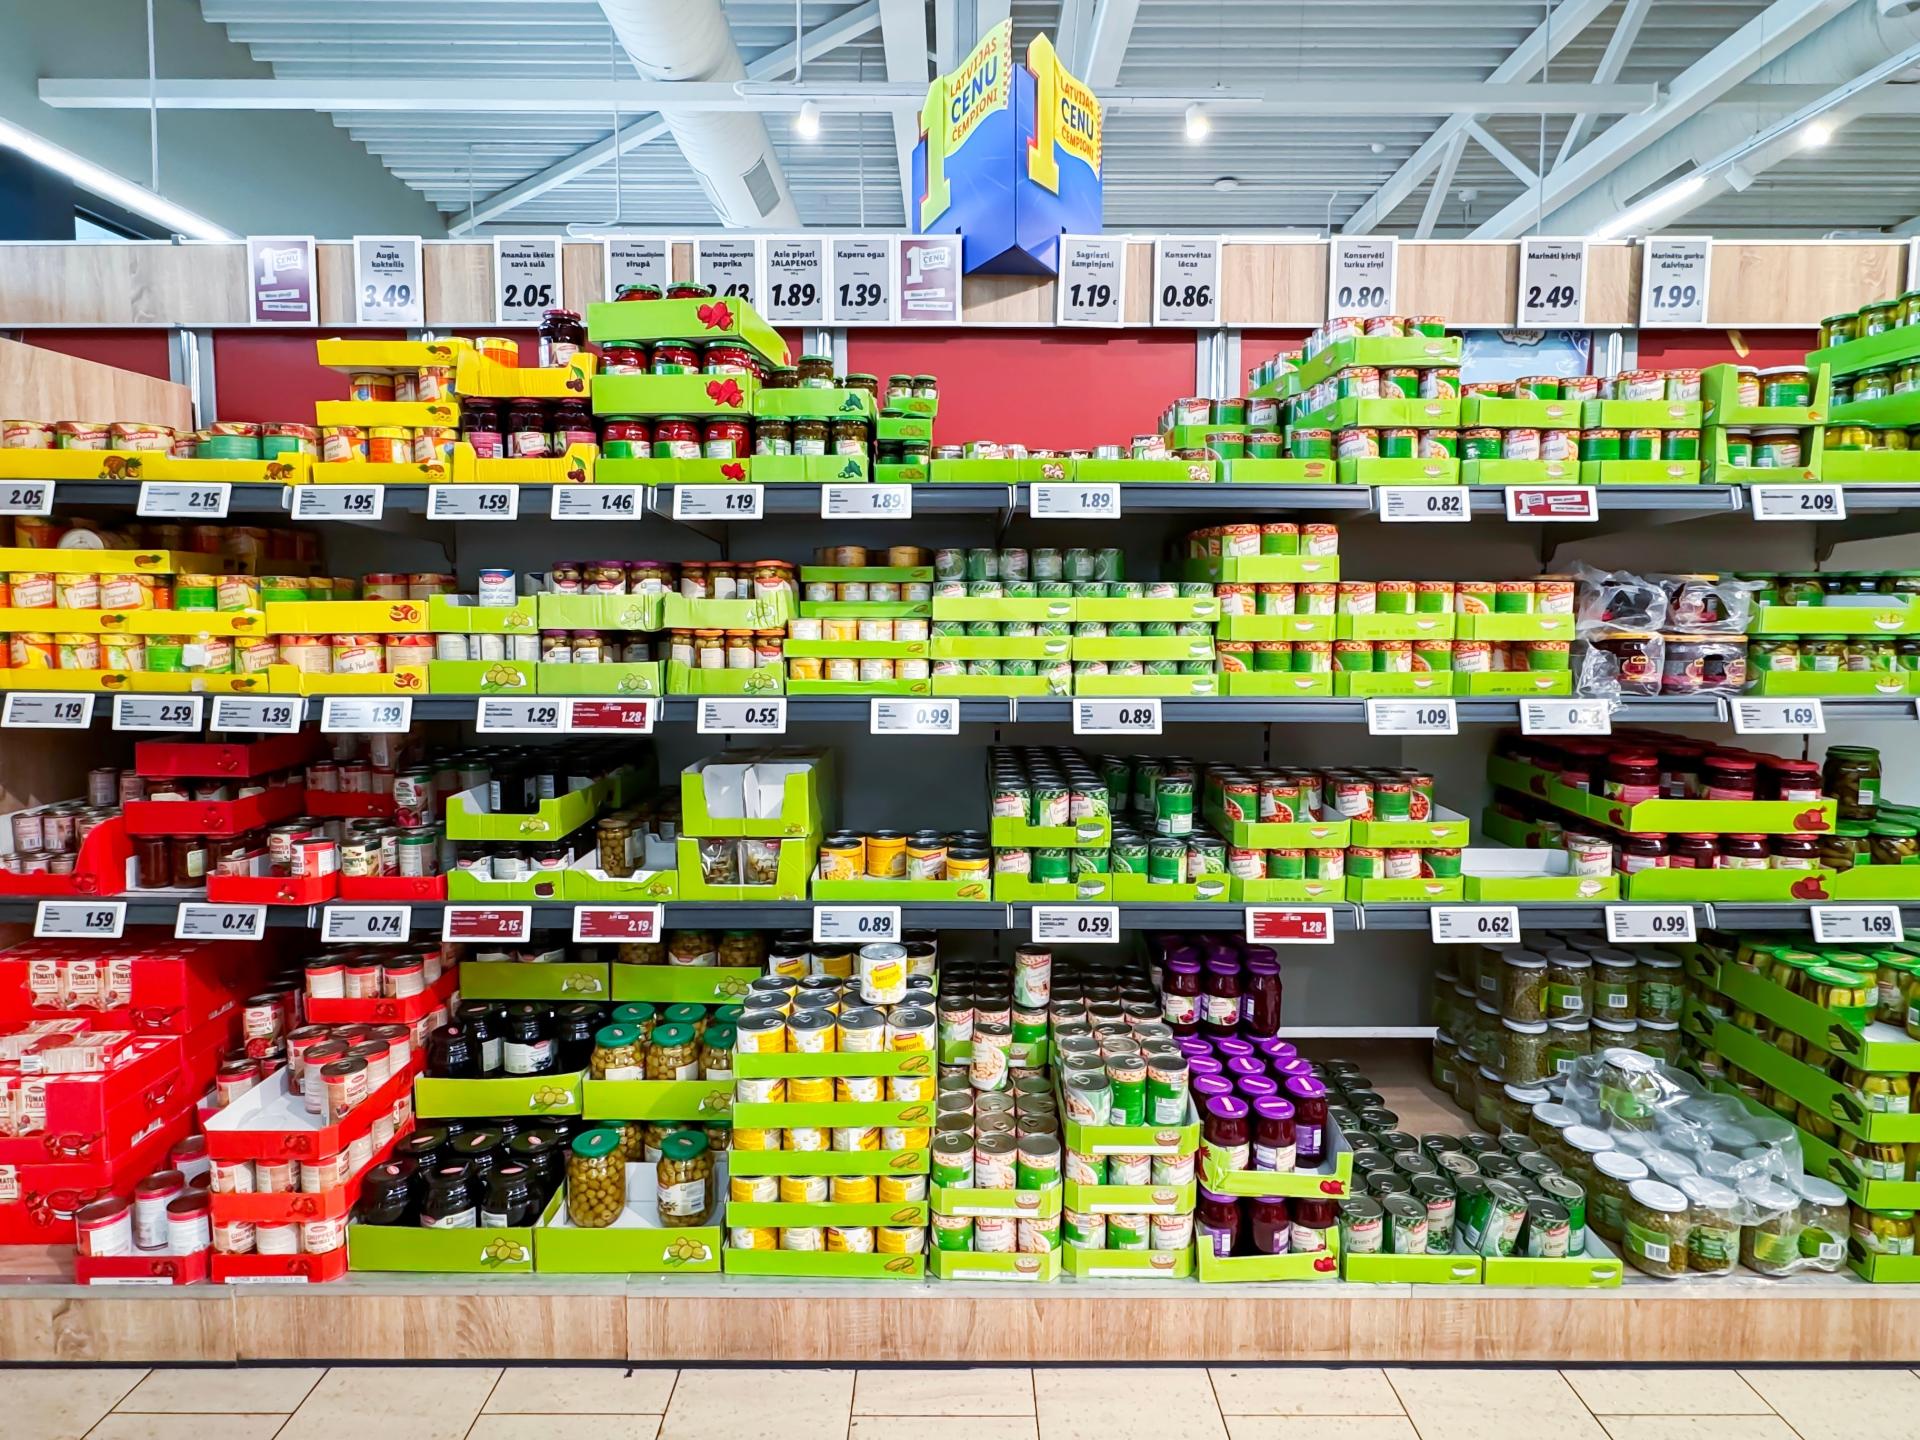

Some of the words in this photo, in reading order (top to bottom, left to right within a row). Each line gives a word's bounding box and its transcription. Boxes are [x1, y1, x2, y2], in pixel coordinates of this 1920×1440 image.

[950, 37, 997, 98] LATVIJAS
[951, 56, 998, 124] CENU
[1060, 80, 1094, 117] LATVIJAS
[1061, 98, 1094, 141] CENU
[837, 251, 866, 260] Kaperu
[364, 284, 411, 307] 3.49
[503, 284, 552, 308] 2.05
[771, 283, 816, 307] 1.89
[839, 283, 883, 307] 1.39
[1069, 283, 1111, 308] 1.19
[1162, 284, 1210, 308] 0.86
[1338, 286, 1386, 309] 0.80
[1527, 285, 1575, 309] 2.49
[1651, 284, 1697, 309] 1.99
[10, 490, 41, 504] 2.05
[189, 492, 219, 506] 2.15
[344, 495, 373, 509] 1.95
[479, 494, 508, 509] 1.59
[601, 494, 632, 509] 1.46
[726, 494, 754, 509] 1.19
[871, 494, 900, 507] 1.89
[1080, 493, 1110, 507] 1.89
[1427, 496, 1460, 511] 0.82
[1801, 494, 1834, 509] 2.09
[54, 703, 81, 718] 1.19
[160, 706, 190, 721] 2.59
[262, 707, 290, 722] 1.39
[371, 706, 400, 722] 1.39
[527, 707, 557, 723] 1.29
[621, 711, 642, 723] 1.28
[745, 707, 776, 723] 0.55
[916, 708, 949, 724] 0.99
[1119, 709, 1151, 724] 0.89
[1416, 708, 1447, 724] 1.09
[1782, 708, 1812, 723] 1.69
[85, 912, 113, 926] 1.59
[222, 914, 254, 929] 0.74
[368, 916, 400, 931] 0.74
[498, 919, 520, 932] 2.15
[627, 920, 649, 932] 2.19
[858, 916, 891, 932] 0.89
[1077, 916, 1109, 932] 0.59
[1302, 920, 1322, 933] 1.28
[1477, 917, 1509, 932] 0.62
[1652, 917, 1685, 932] 0.99
[1862, 916, 1891, 932] 1.69
